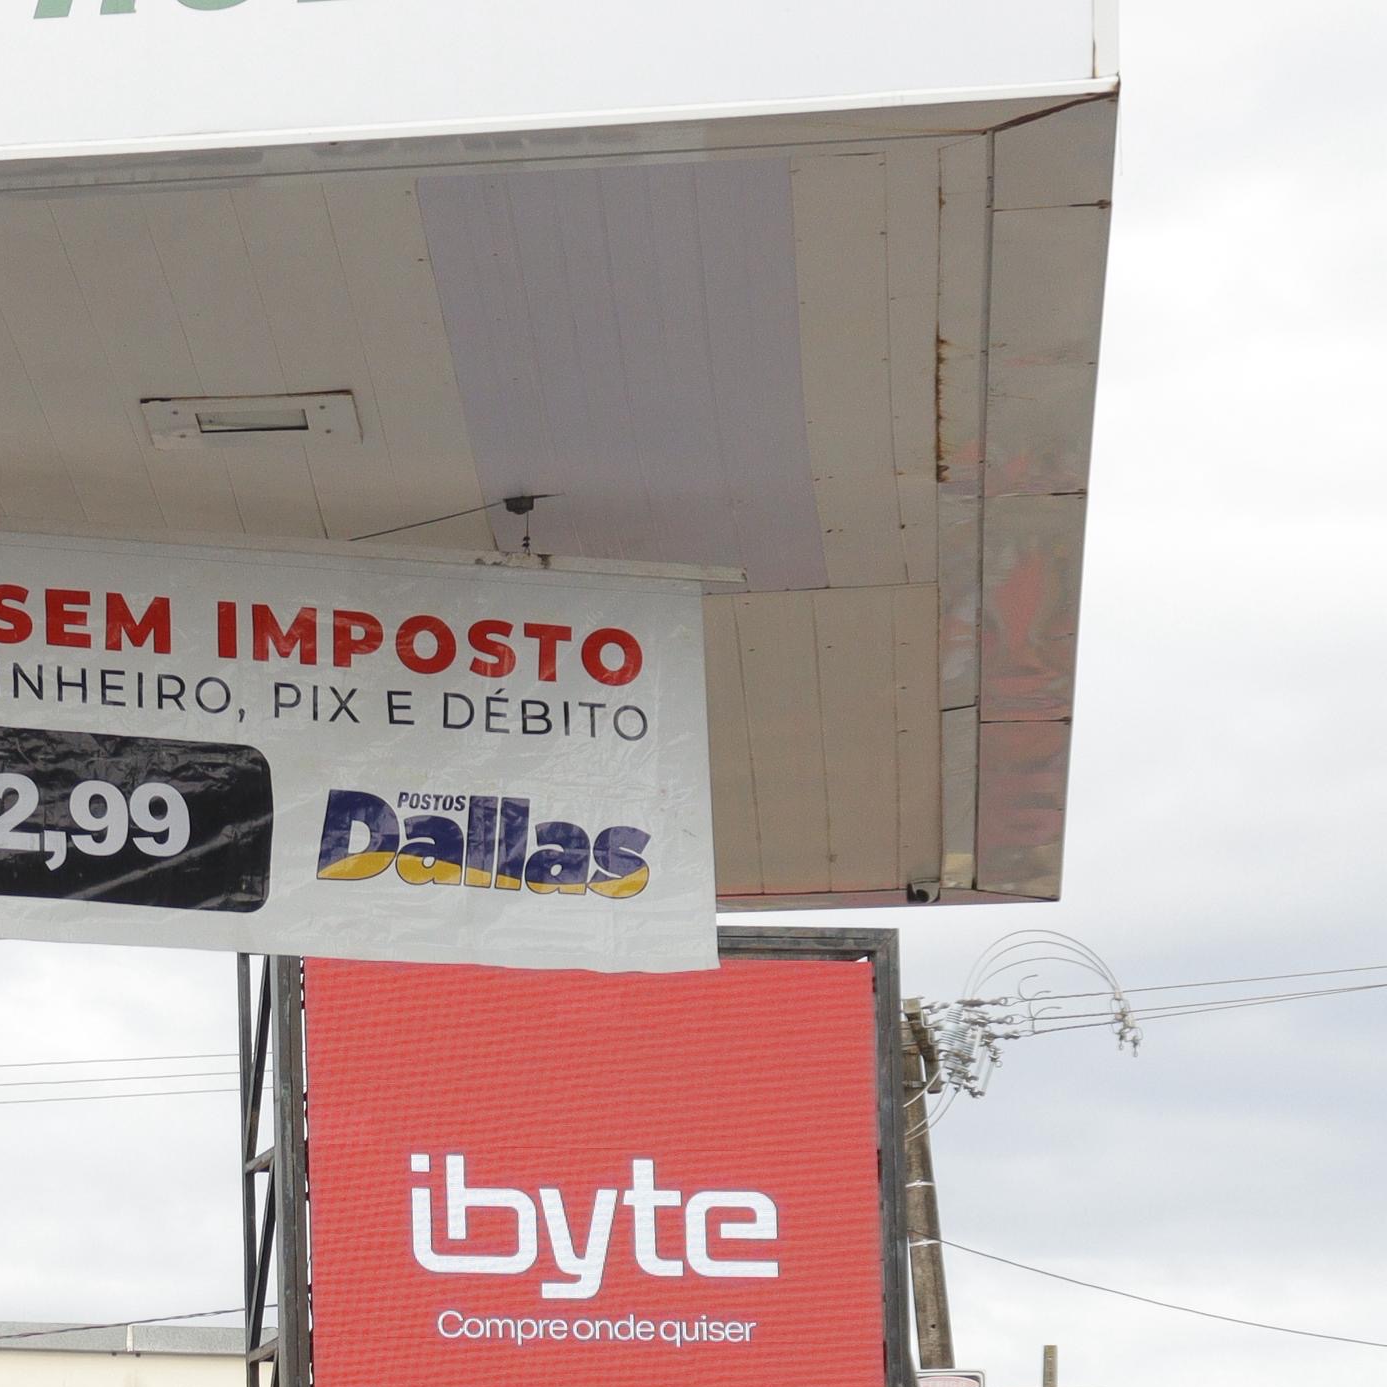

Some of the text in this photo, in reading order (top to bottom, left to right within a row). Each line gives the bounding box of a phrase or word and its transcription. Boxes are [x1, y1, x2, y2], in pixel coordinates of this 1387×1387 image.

[217, 601, 644, 687] IMPOSTO
[273, 682, 361, 724] PIX
[387, 690, 415, 726] E
[443, 688, 649, 742] DÉBITO
[397, 792, 465, 811] POSTOS
[316, 789, 652, 900] Dallas
[410, 1153, 779, 1299] ibyte
[437, 1310, 756, 1347] Compre onde quiser
